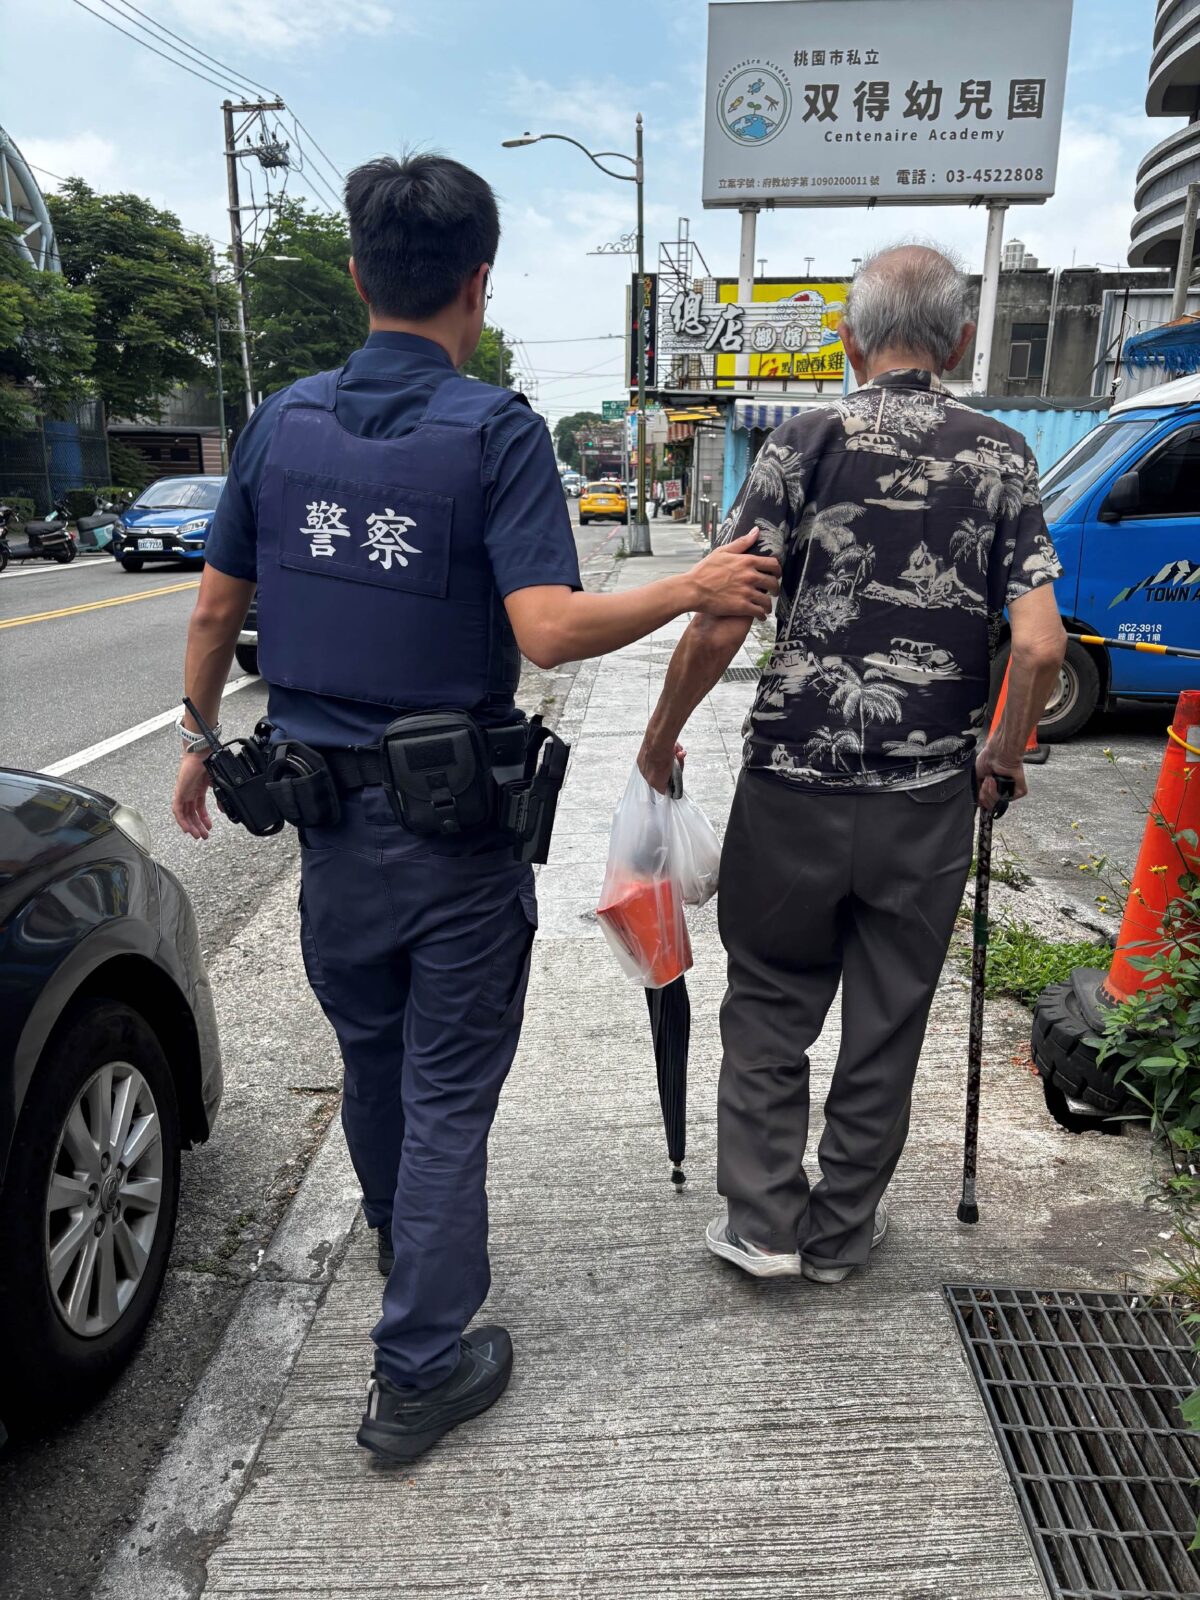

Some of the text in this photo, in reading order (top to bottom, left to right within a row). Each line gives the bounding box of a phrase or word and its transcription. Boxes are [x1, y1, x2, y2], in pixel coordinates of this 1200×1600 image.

[793, 49, 880, 67] 桃園市私立
[802, 78, 1046, 122] 双得幼兒園
[824, 128, 1005, 143] Centenaire Academy
[946, 168, 1044, 184] 03-4522808
[299, 500, 423, 570] 警察
[1145, 588, 1190, 602] TOWN
